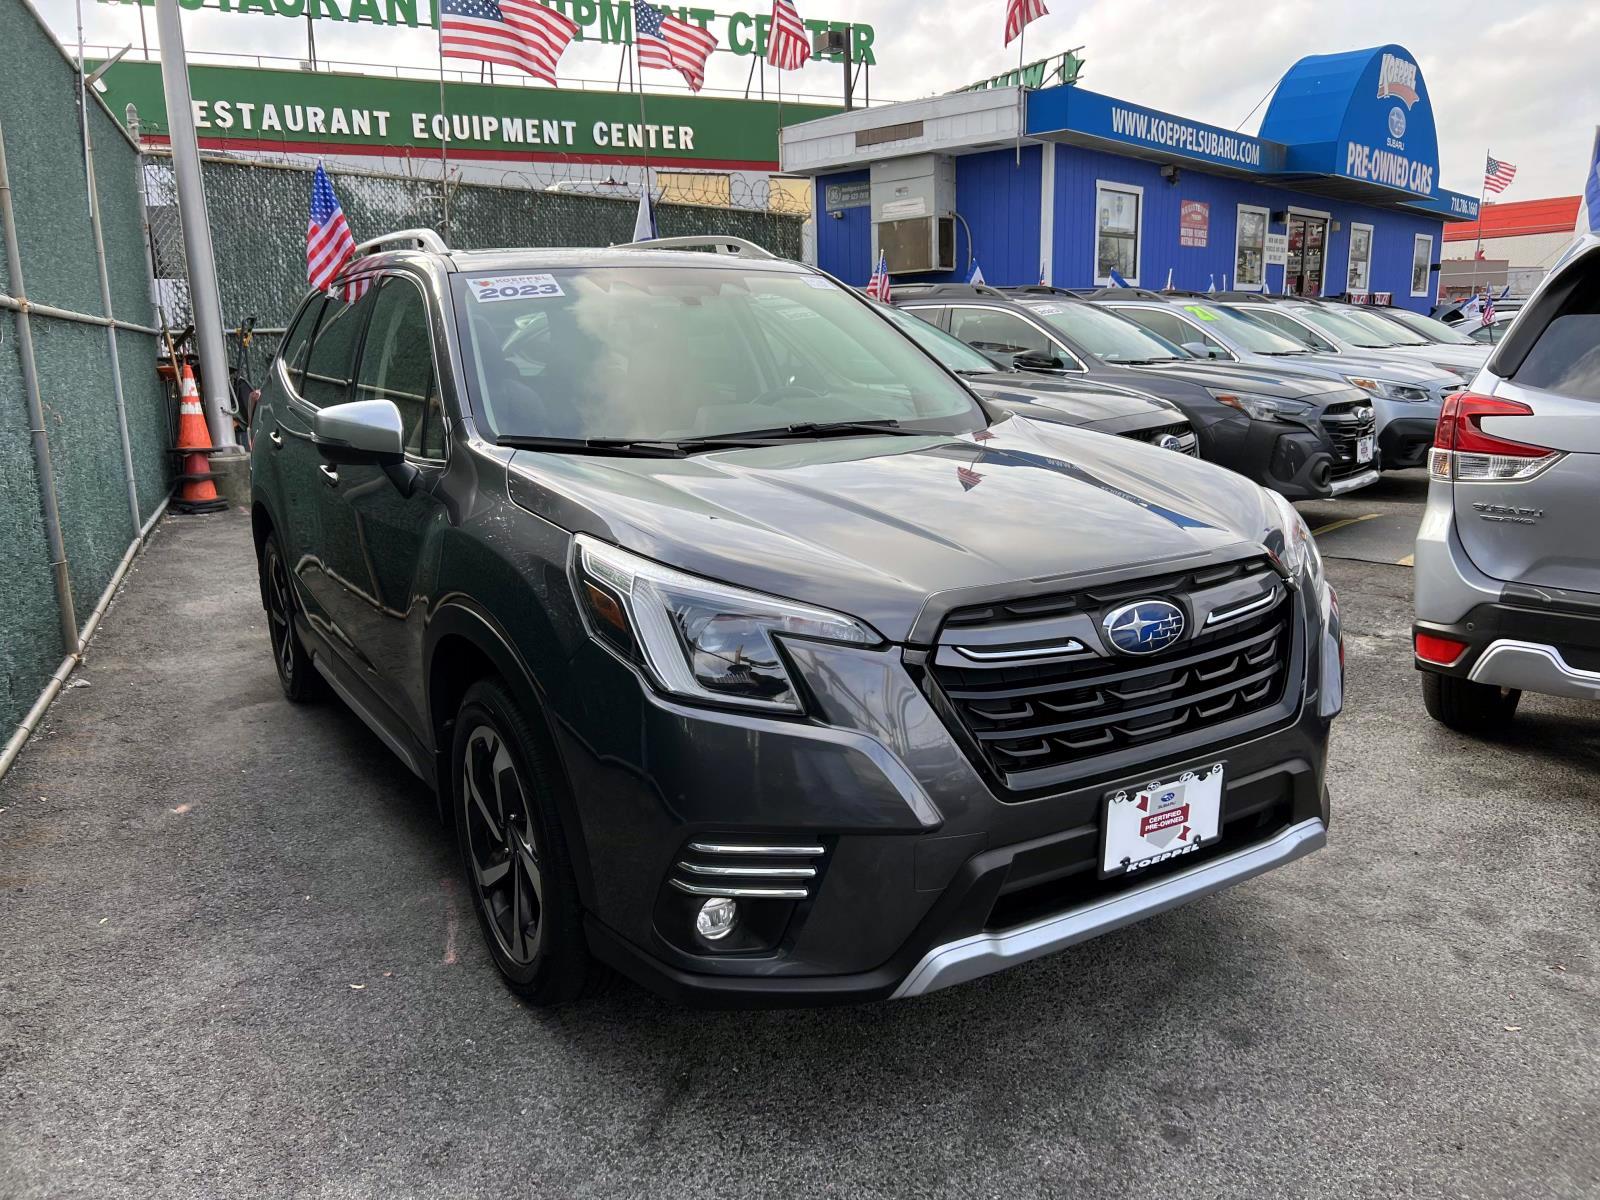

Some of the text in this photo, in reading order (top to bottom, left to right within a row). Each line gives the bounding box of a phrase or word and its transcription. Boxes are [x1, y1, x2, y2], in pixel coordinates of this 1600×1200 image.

[728, 11, 876, 65] CETER
[1379, 54, 1417, 98] KOEPPEL
[190, 100, 695, 150] ESTAURANT EQUIPMENT CENTER
[1112, 106, 1260, 166] WWW.KOEPPELSUBARU.COM
[1387, 138, 1405, 150] SUBARU
[1346, 142, 1433, 195] PRE-OWNED CARS
[480, 284, 559, 299] 2023
[1144, 815, 1185, 832] PRE-OWNED
[1149, 810, 1182, 823] CERTIFIED
[1127, 844, 1200, 872] KOEPPEL
